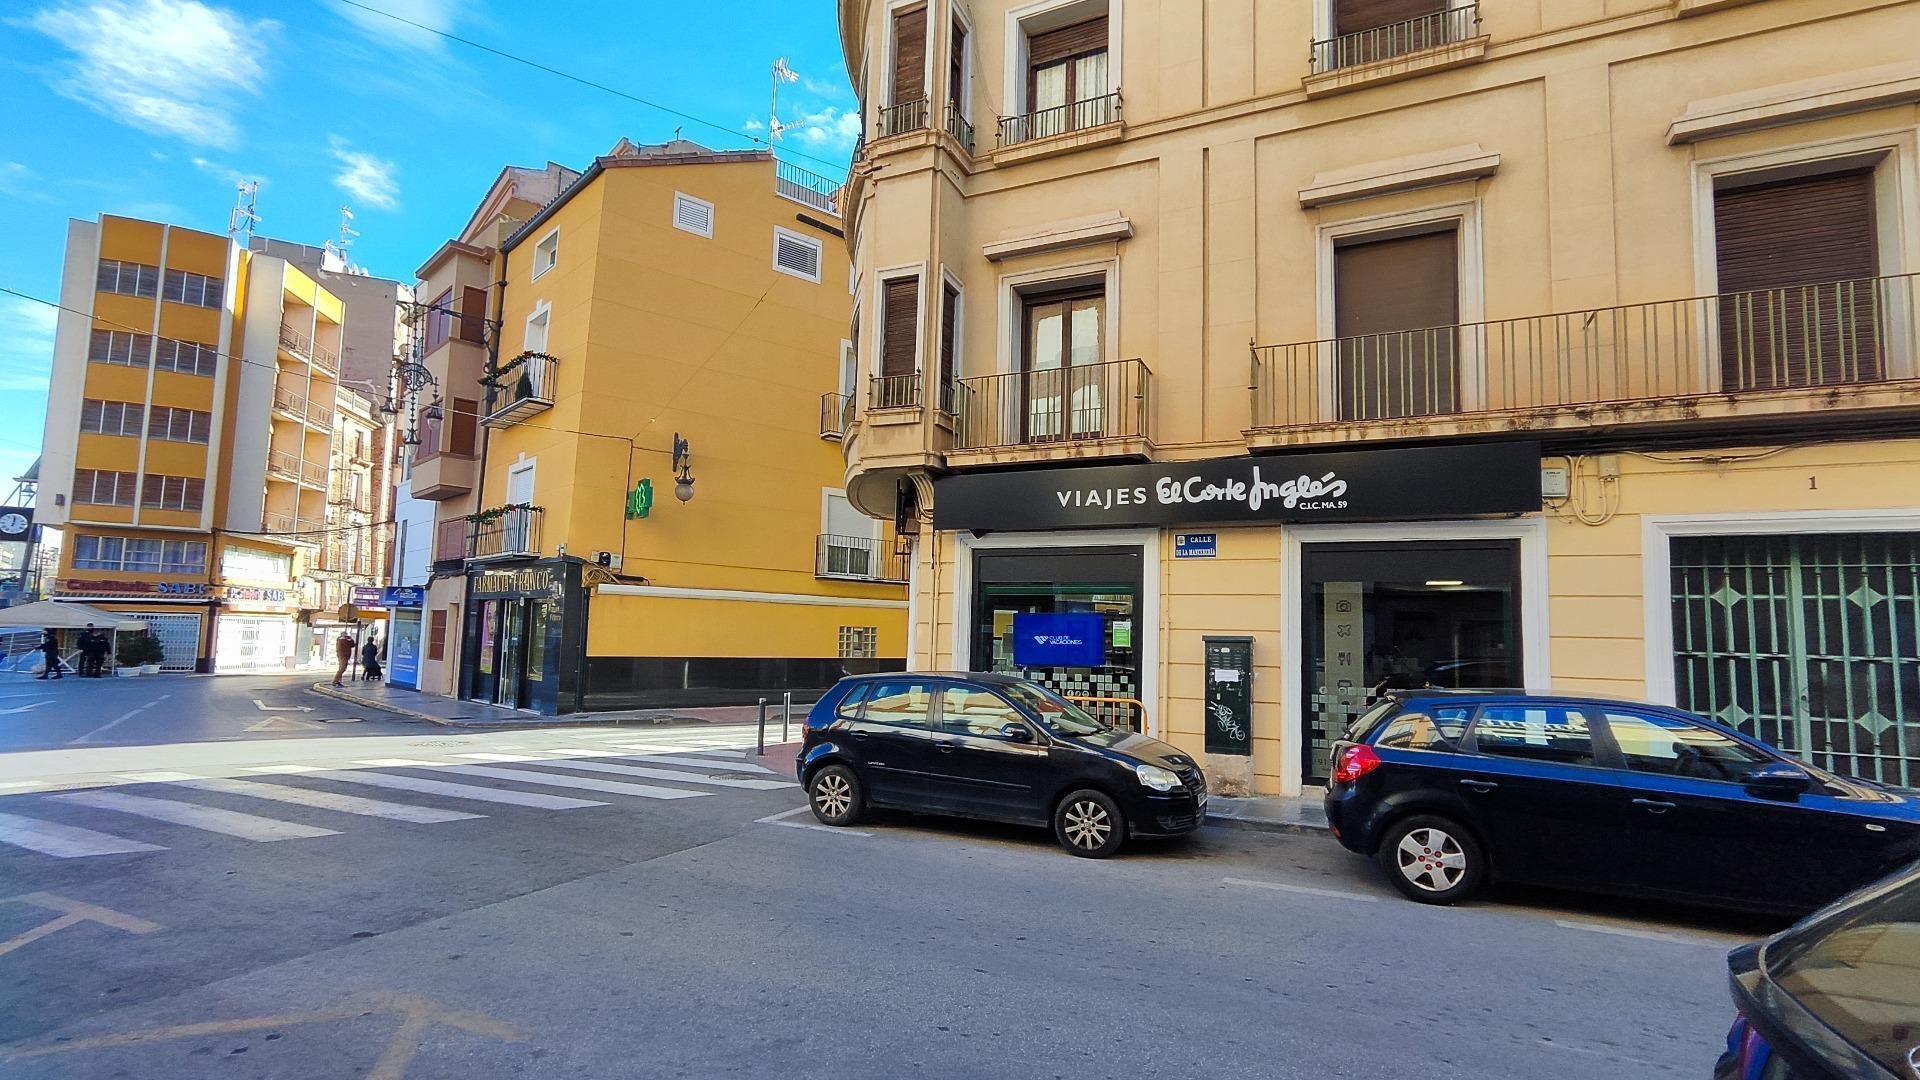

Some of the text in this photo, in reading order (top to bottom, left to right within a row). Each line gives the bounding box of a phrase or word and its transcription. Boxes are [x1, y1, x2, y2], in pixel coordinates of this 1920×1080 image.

[1056, 466, 1348, 511] VIAJES El Corte Inglés
[1808, 476, 1818, 490] 1
[1321, 501, 1337, 509] MA.
[473, 571, 549, 593] FARMACIA FRANCO
